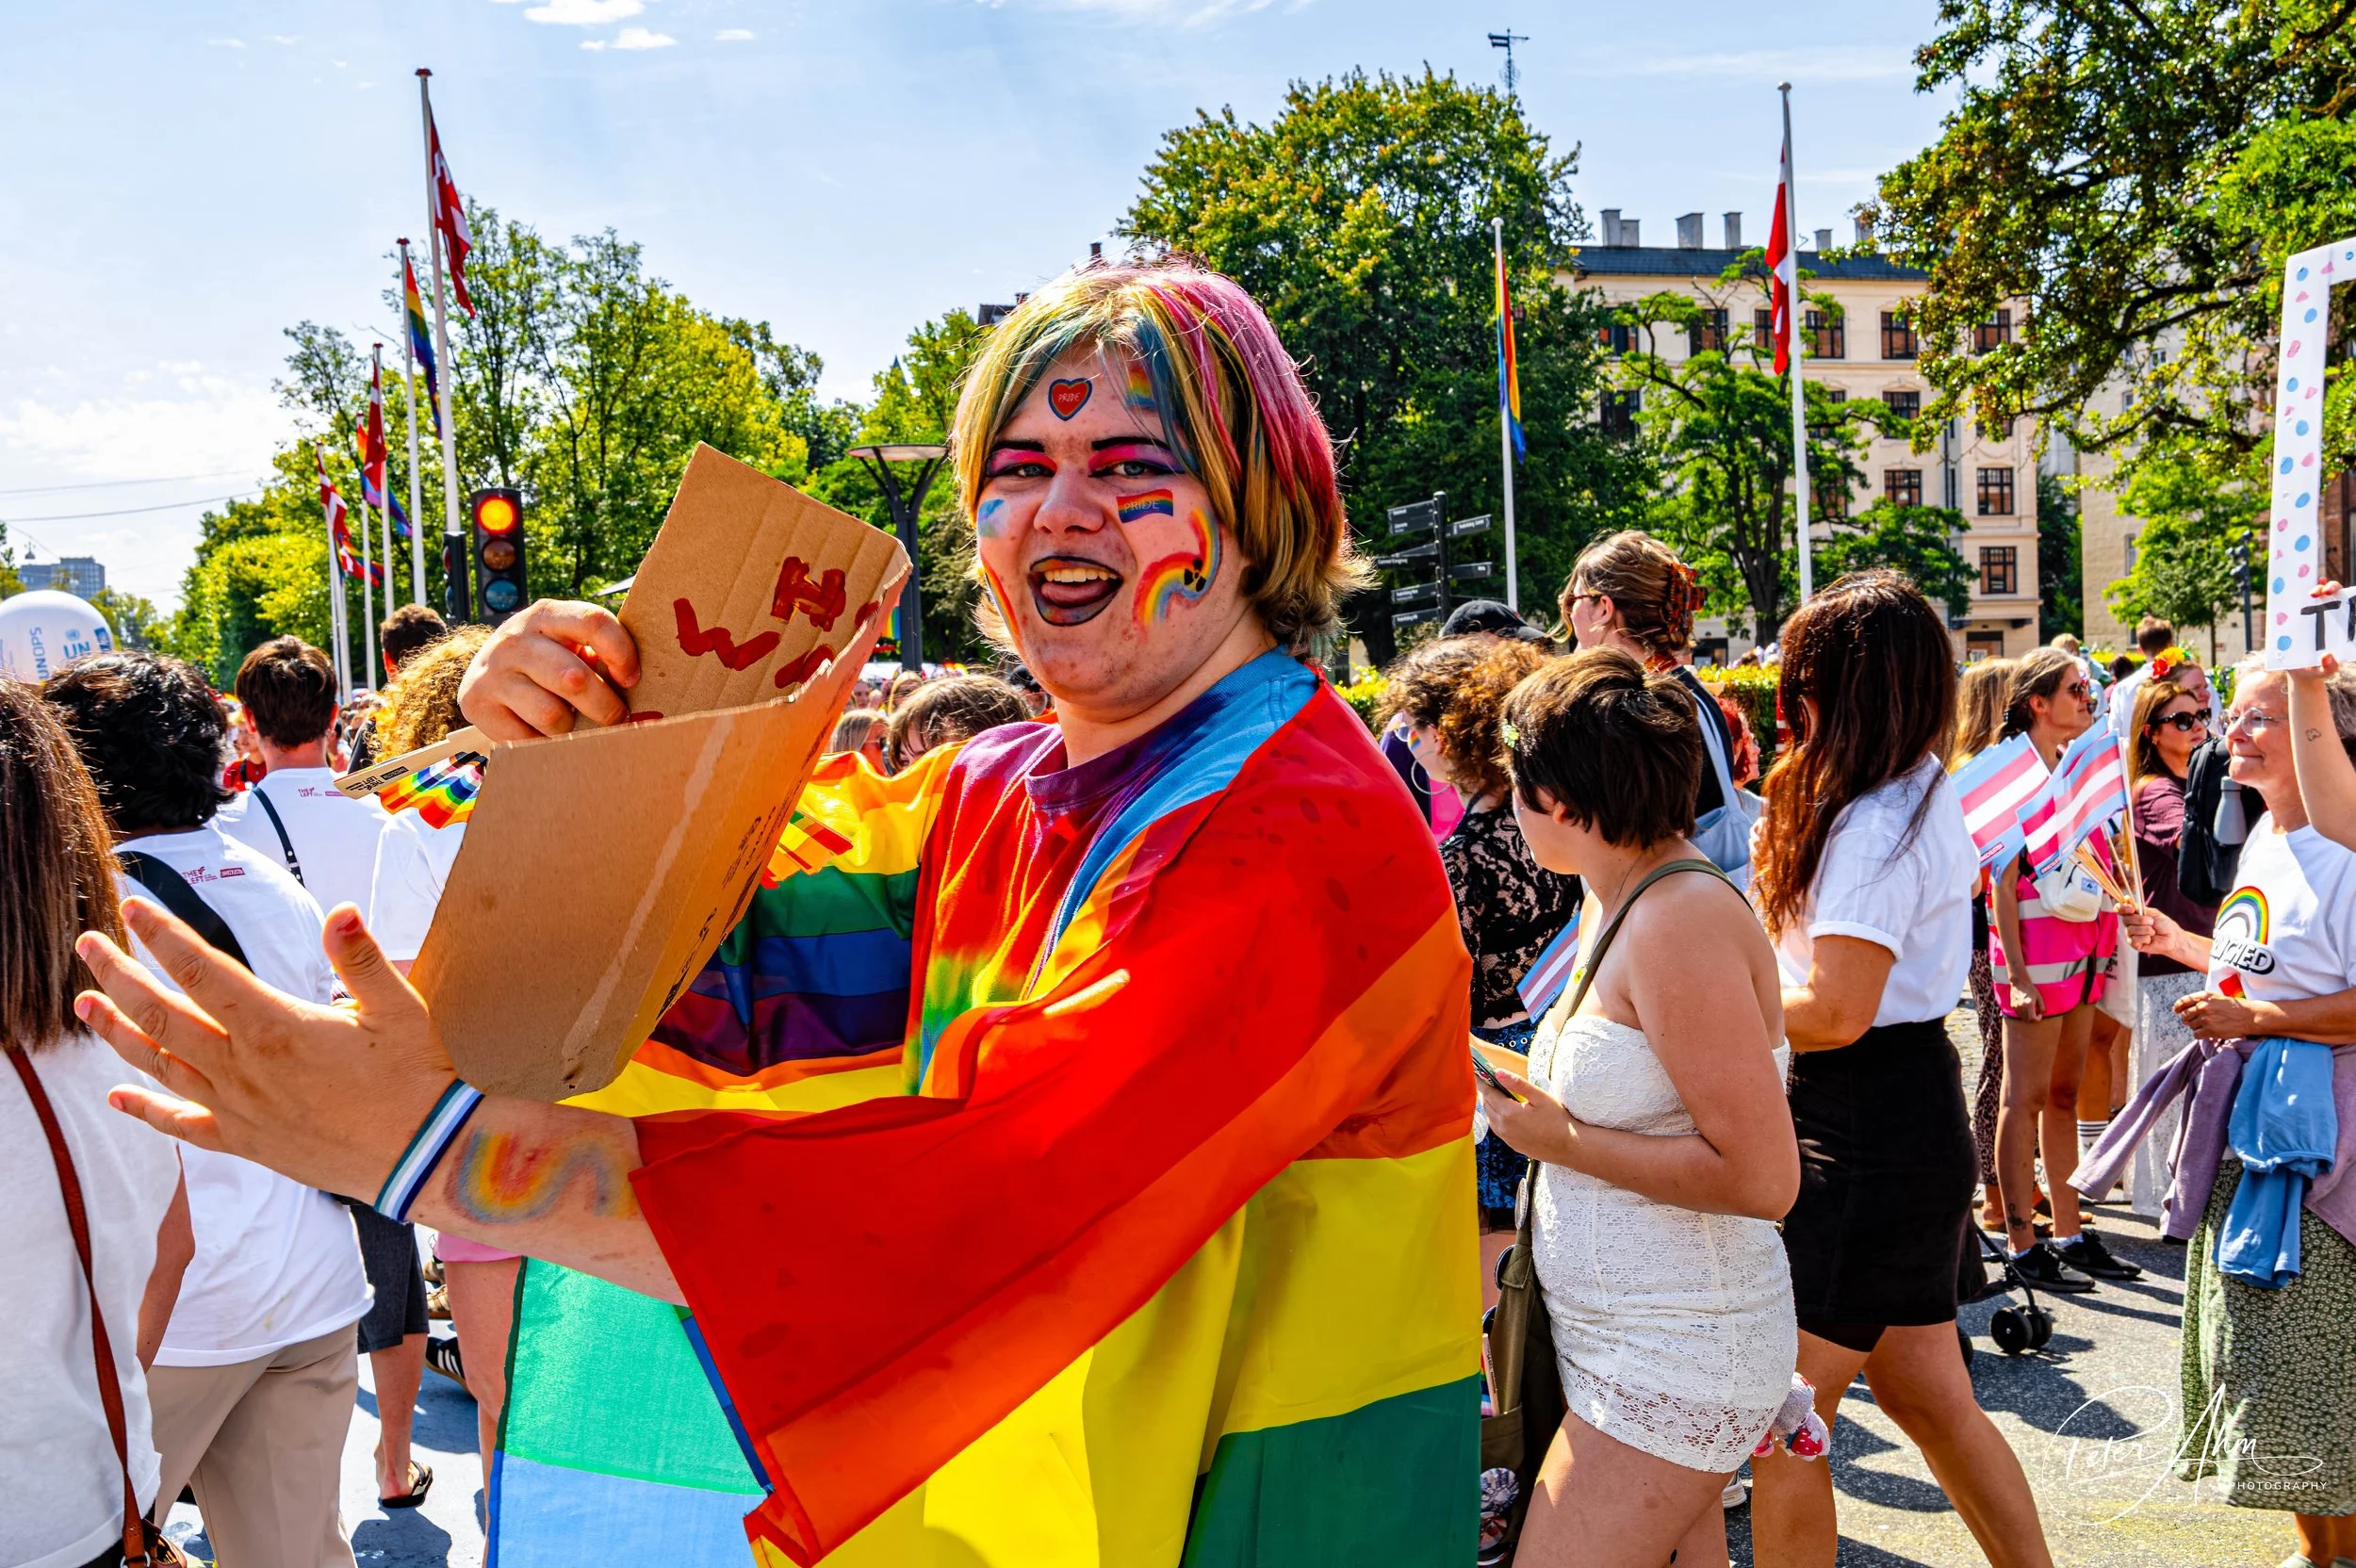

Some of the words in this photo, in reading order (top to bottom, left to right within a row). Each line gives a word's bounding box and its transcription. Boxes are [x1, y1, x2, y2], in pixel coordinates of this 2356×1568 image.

[1057, 392, 1081, 402] PRIDE
[1123, 500, 1160, 514] PRIDE
[29, 627, 50, 679] UNOPS
